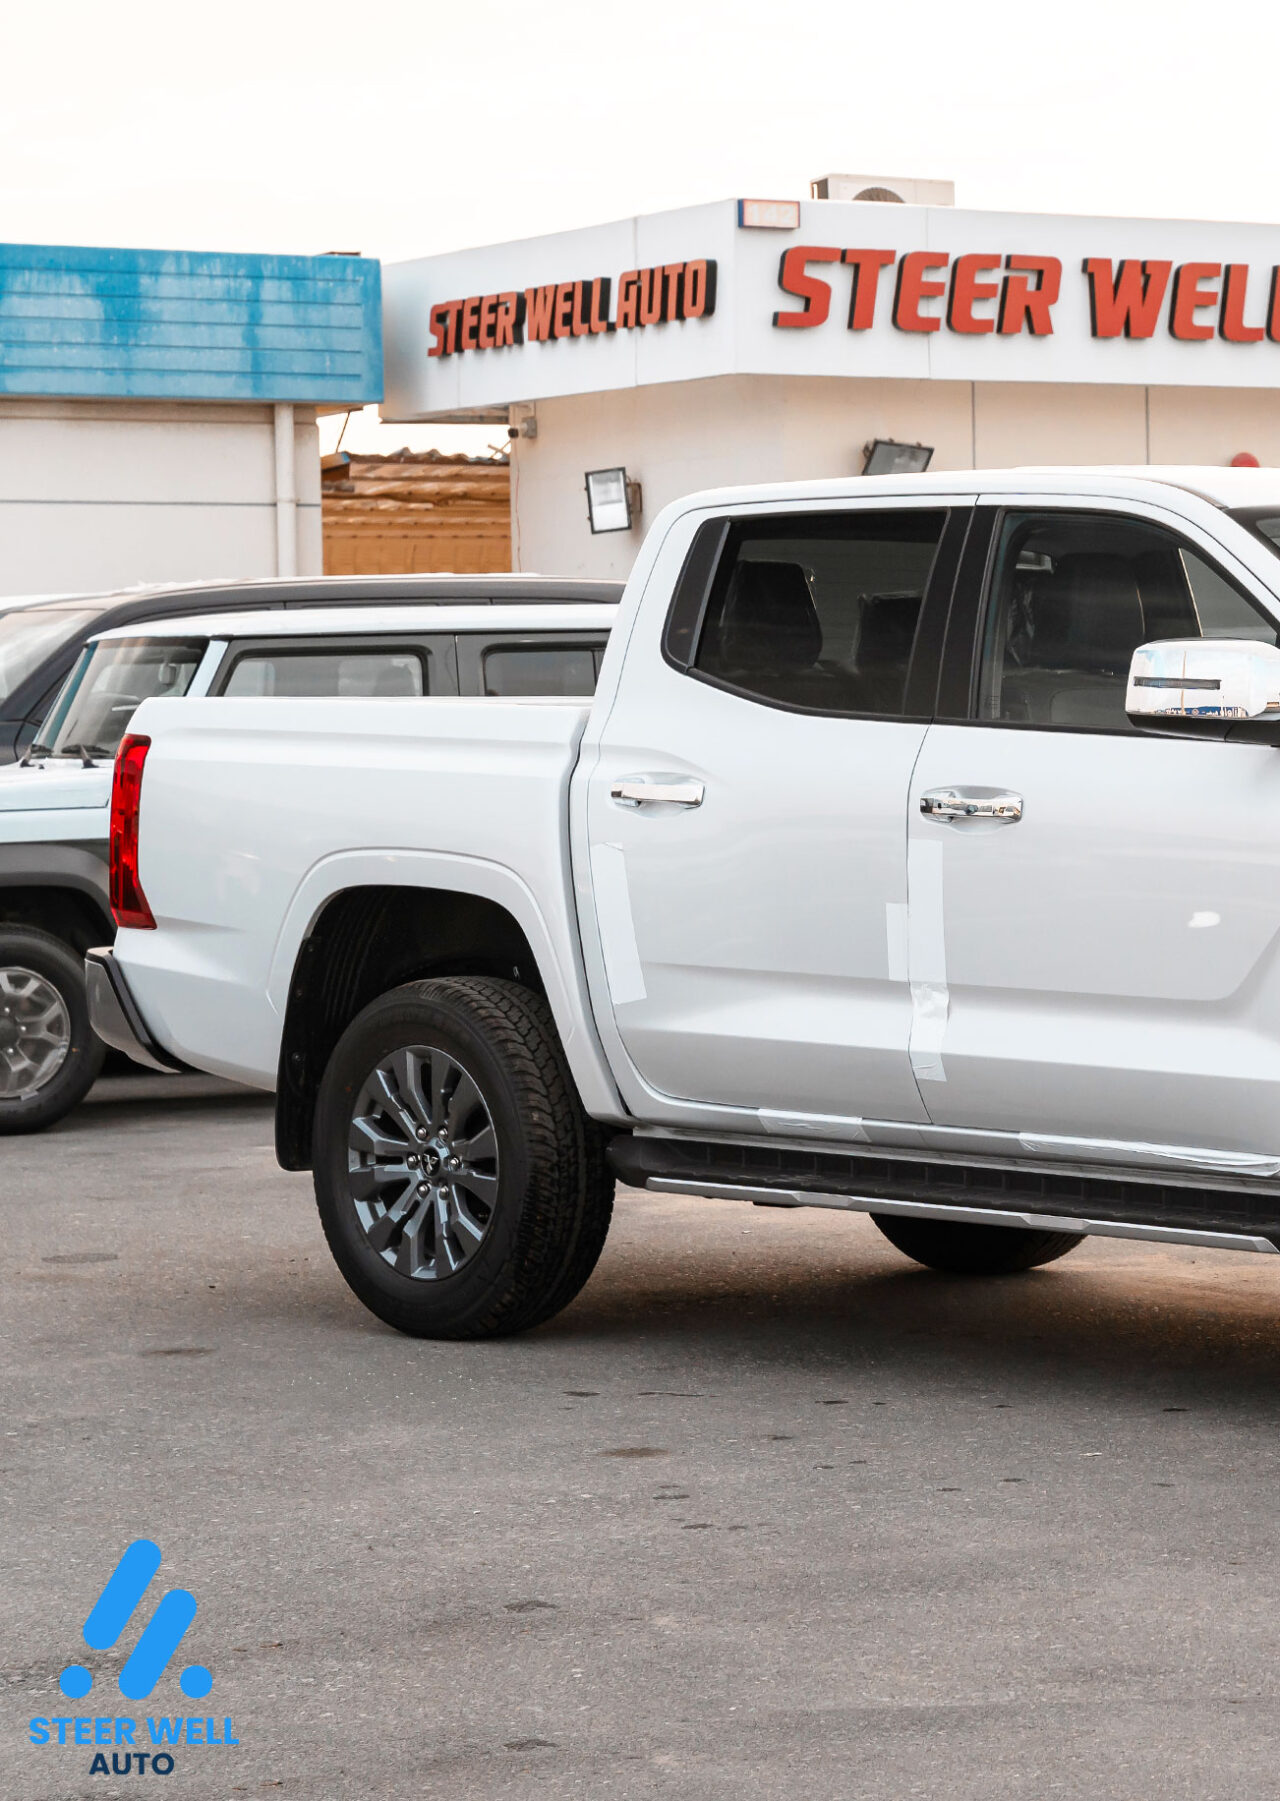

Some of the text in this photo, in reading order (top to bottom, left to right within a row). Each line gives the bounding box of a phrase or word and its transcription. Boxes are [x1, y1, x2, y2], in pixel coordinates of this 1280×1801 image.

[748, 203, 796, 224] 142
[428, 259, 717, 358] STEER WELL AUTO
[772, 246, 1062, 335] STEER
